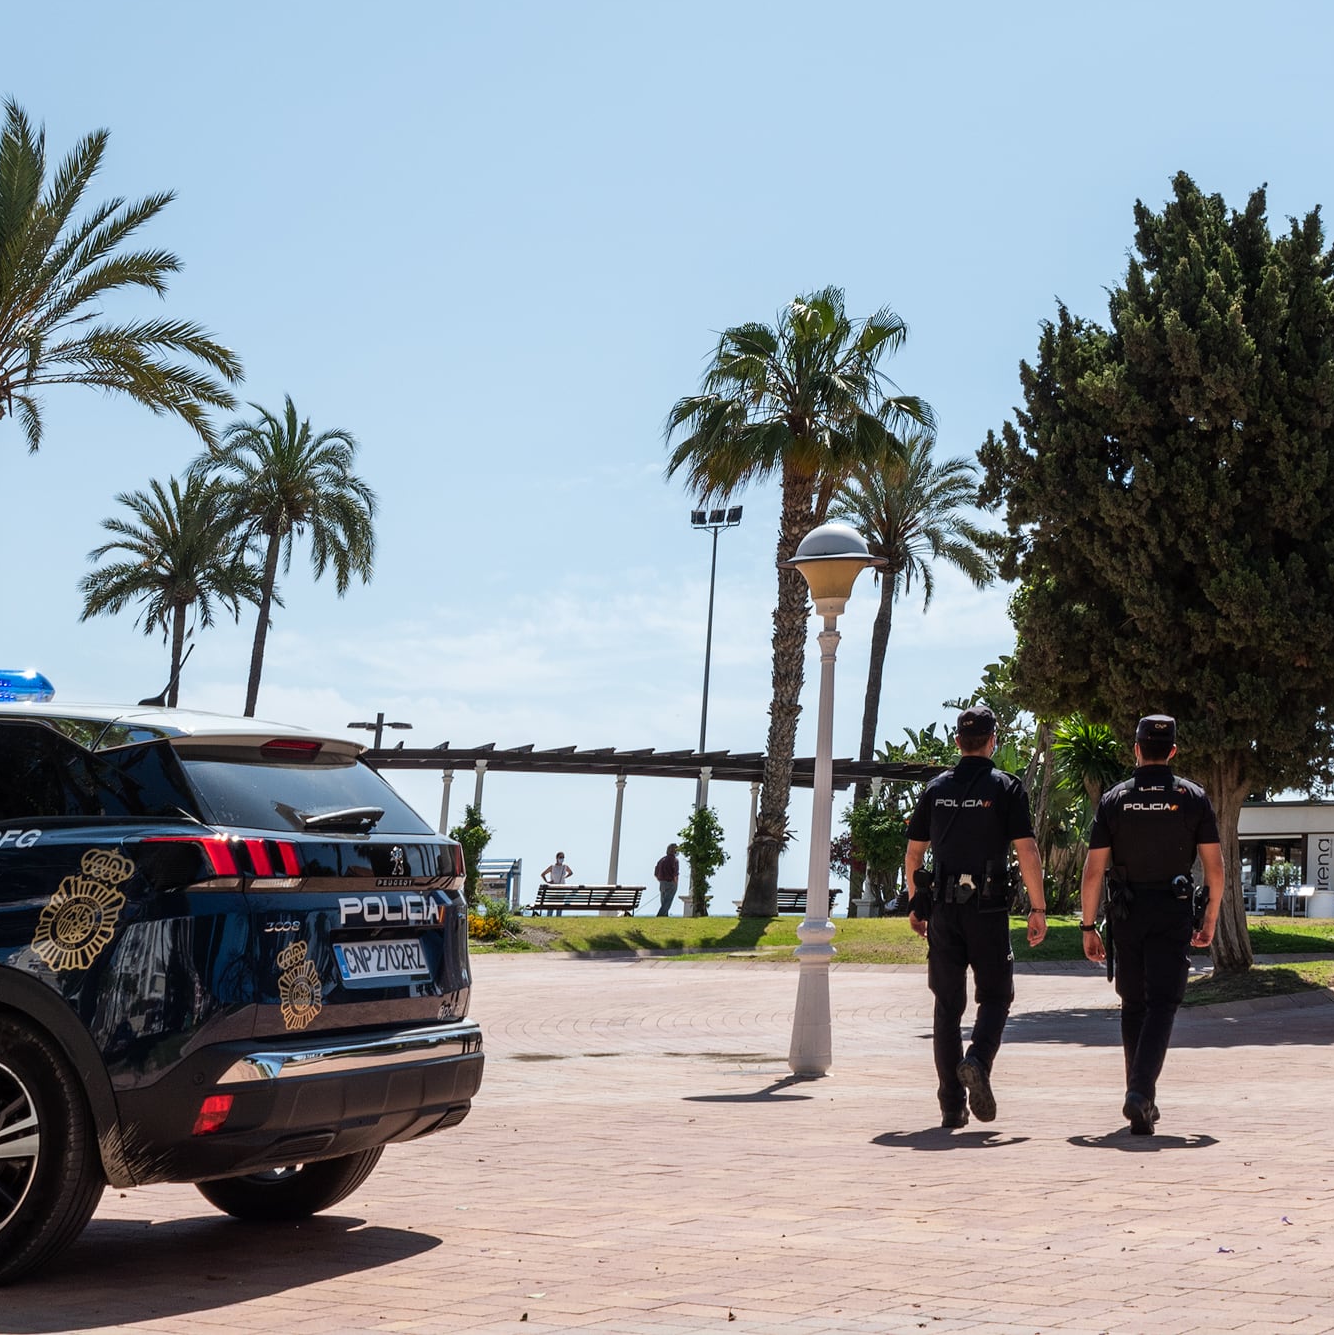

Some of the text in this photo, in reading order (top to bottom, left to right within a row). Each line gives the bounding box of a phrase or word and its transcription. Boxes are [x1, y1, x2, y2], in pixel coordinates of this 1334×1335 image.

[1123, 803, 1171, 811] POLICIA
[377, 879, 413, 887] PEUGEOT
[264, 921, 301, 933] 3008
